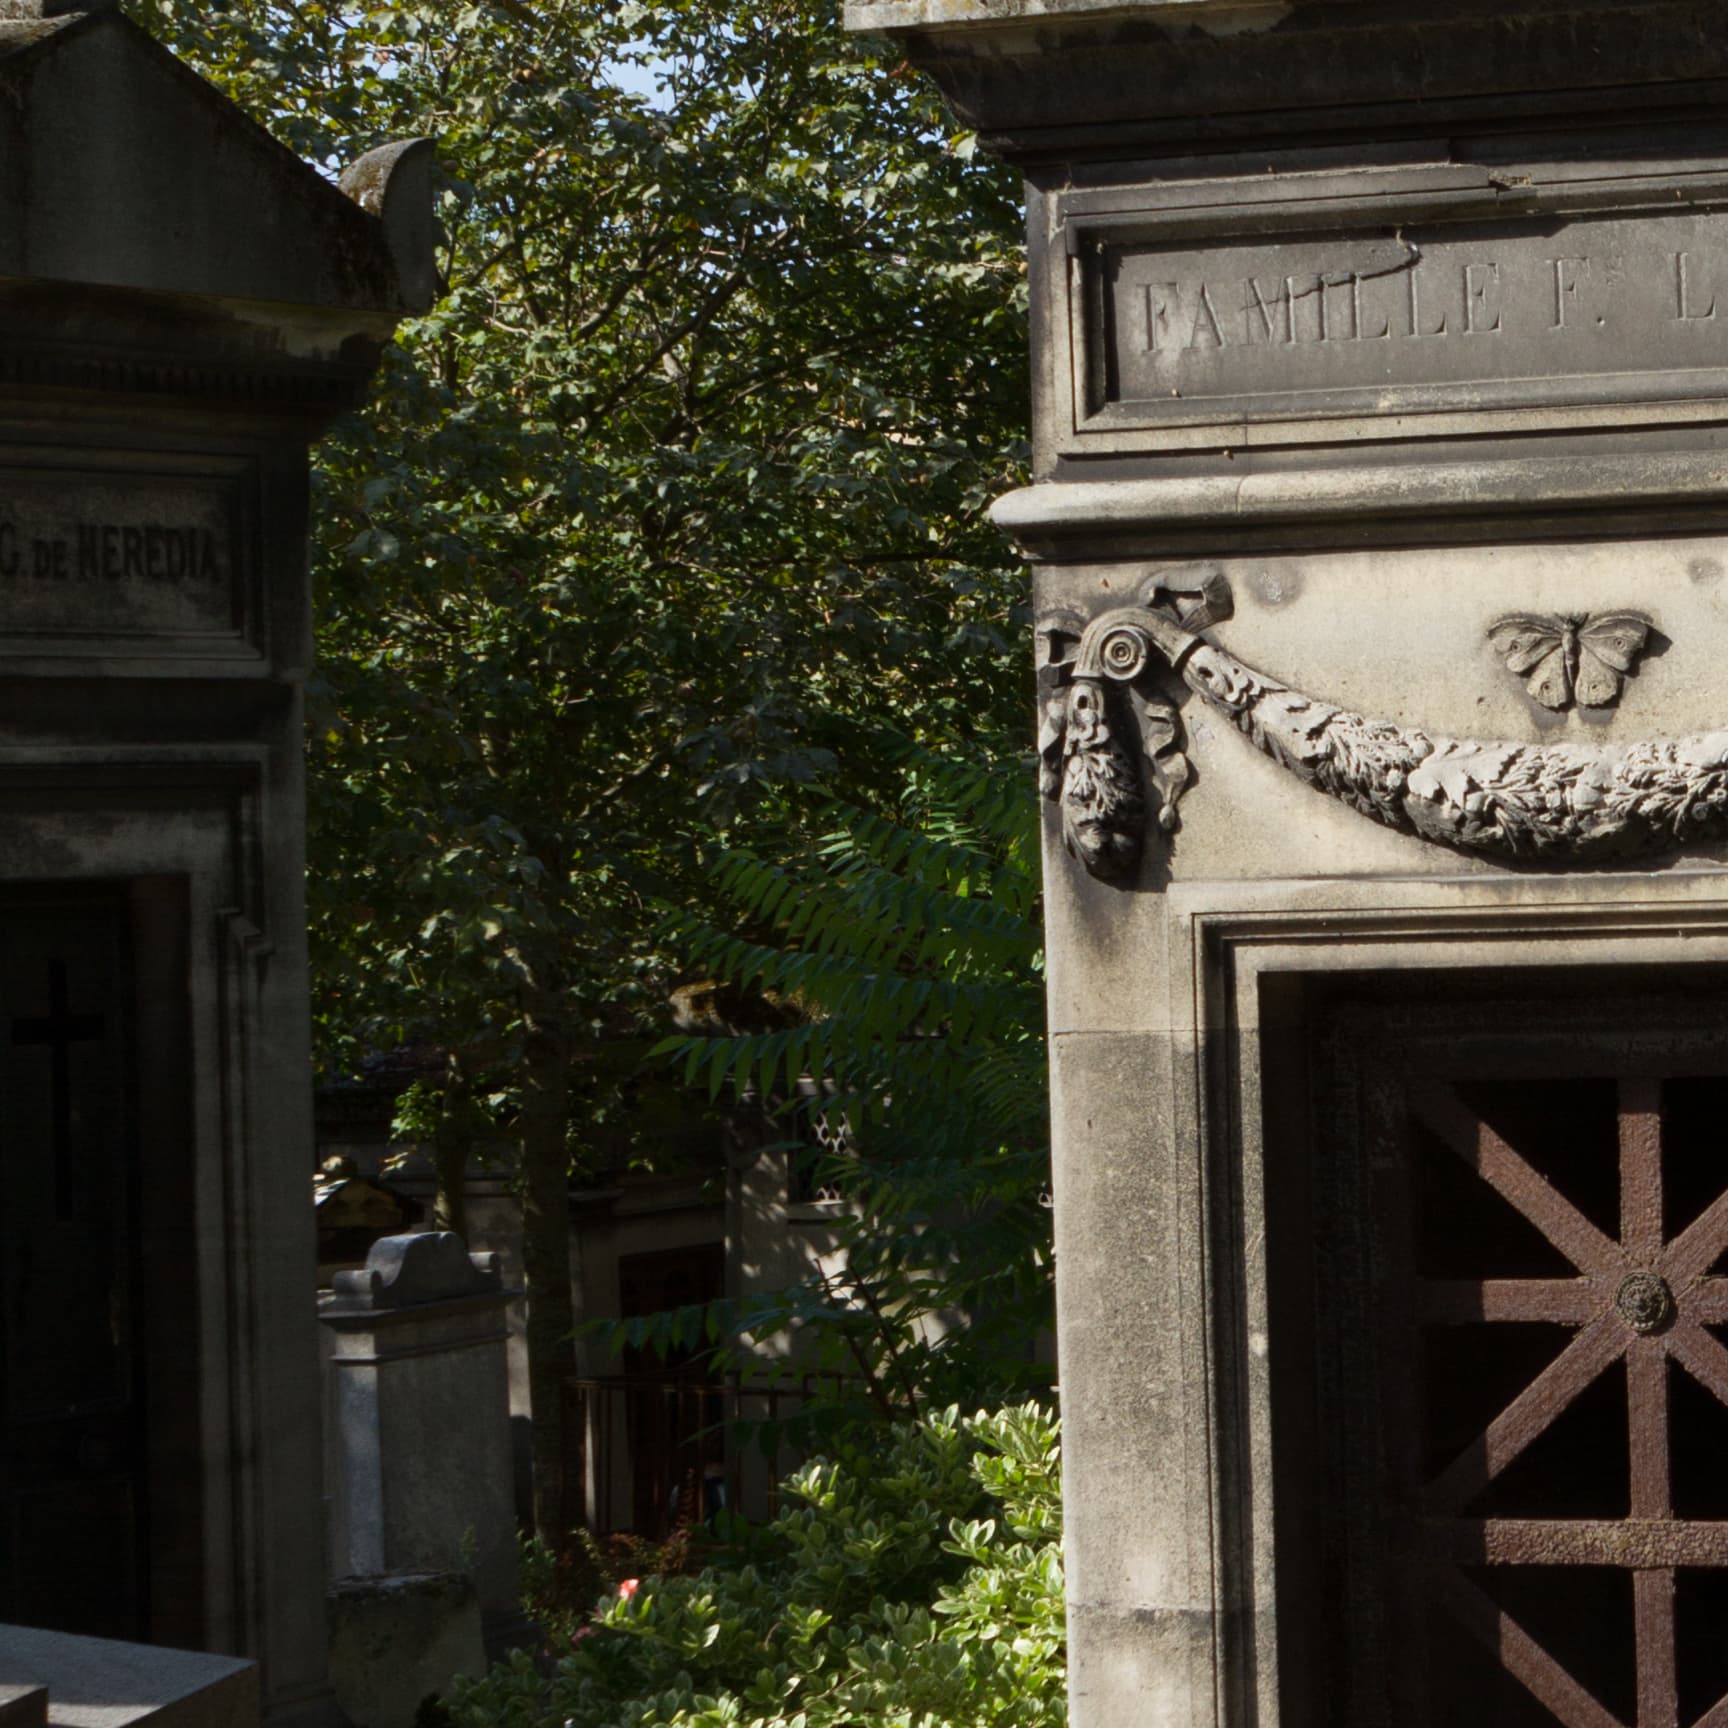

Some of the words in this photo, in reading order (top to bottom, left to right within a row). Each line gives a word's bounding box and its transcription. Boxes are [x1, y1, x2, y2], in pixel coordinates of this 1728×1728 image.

[1138, 262, 1503, 355] FAMILLE
[32, 538, 67, 579] DE
[78, 522, 221, 582] HEREDIA
